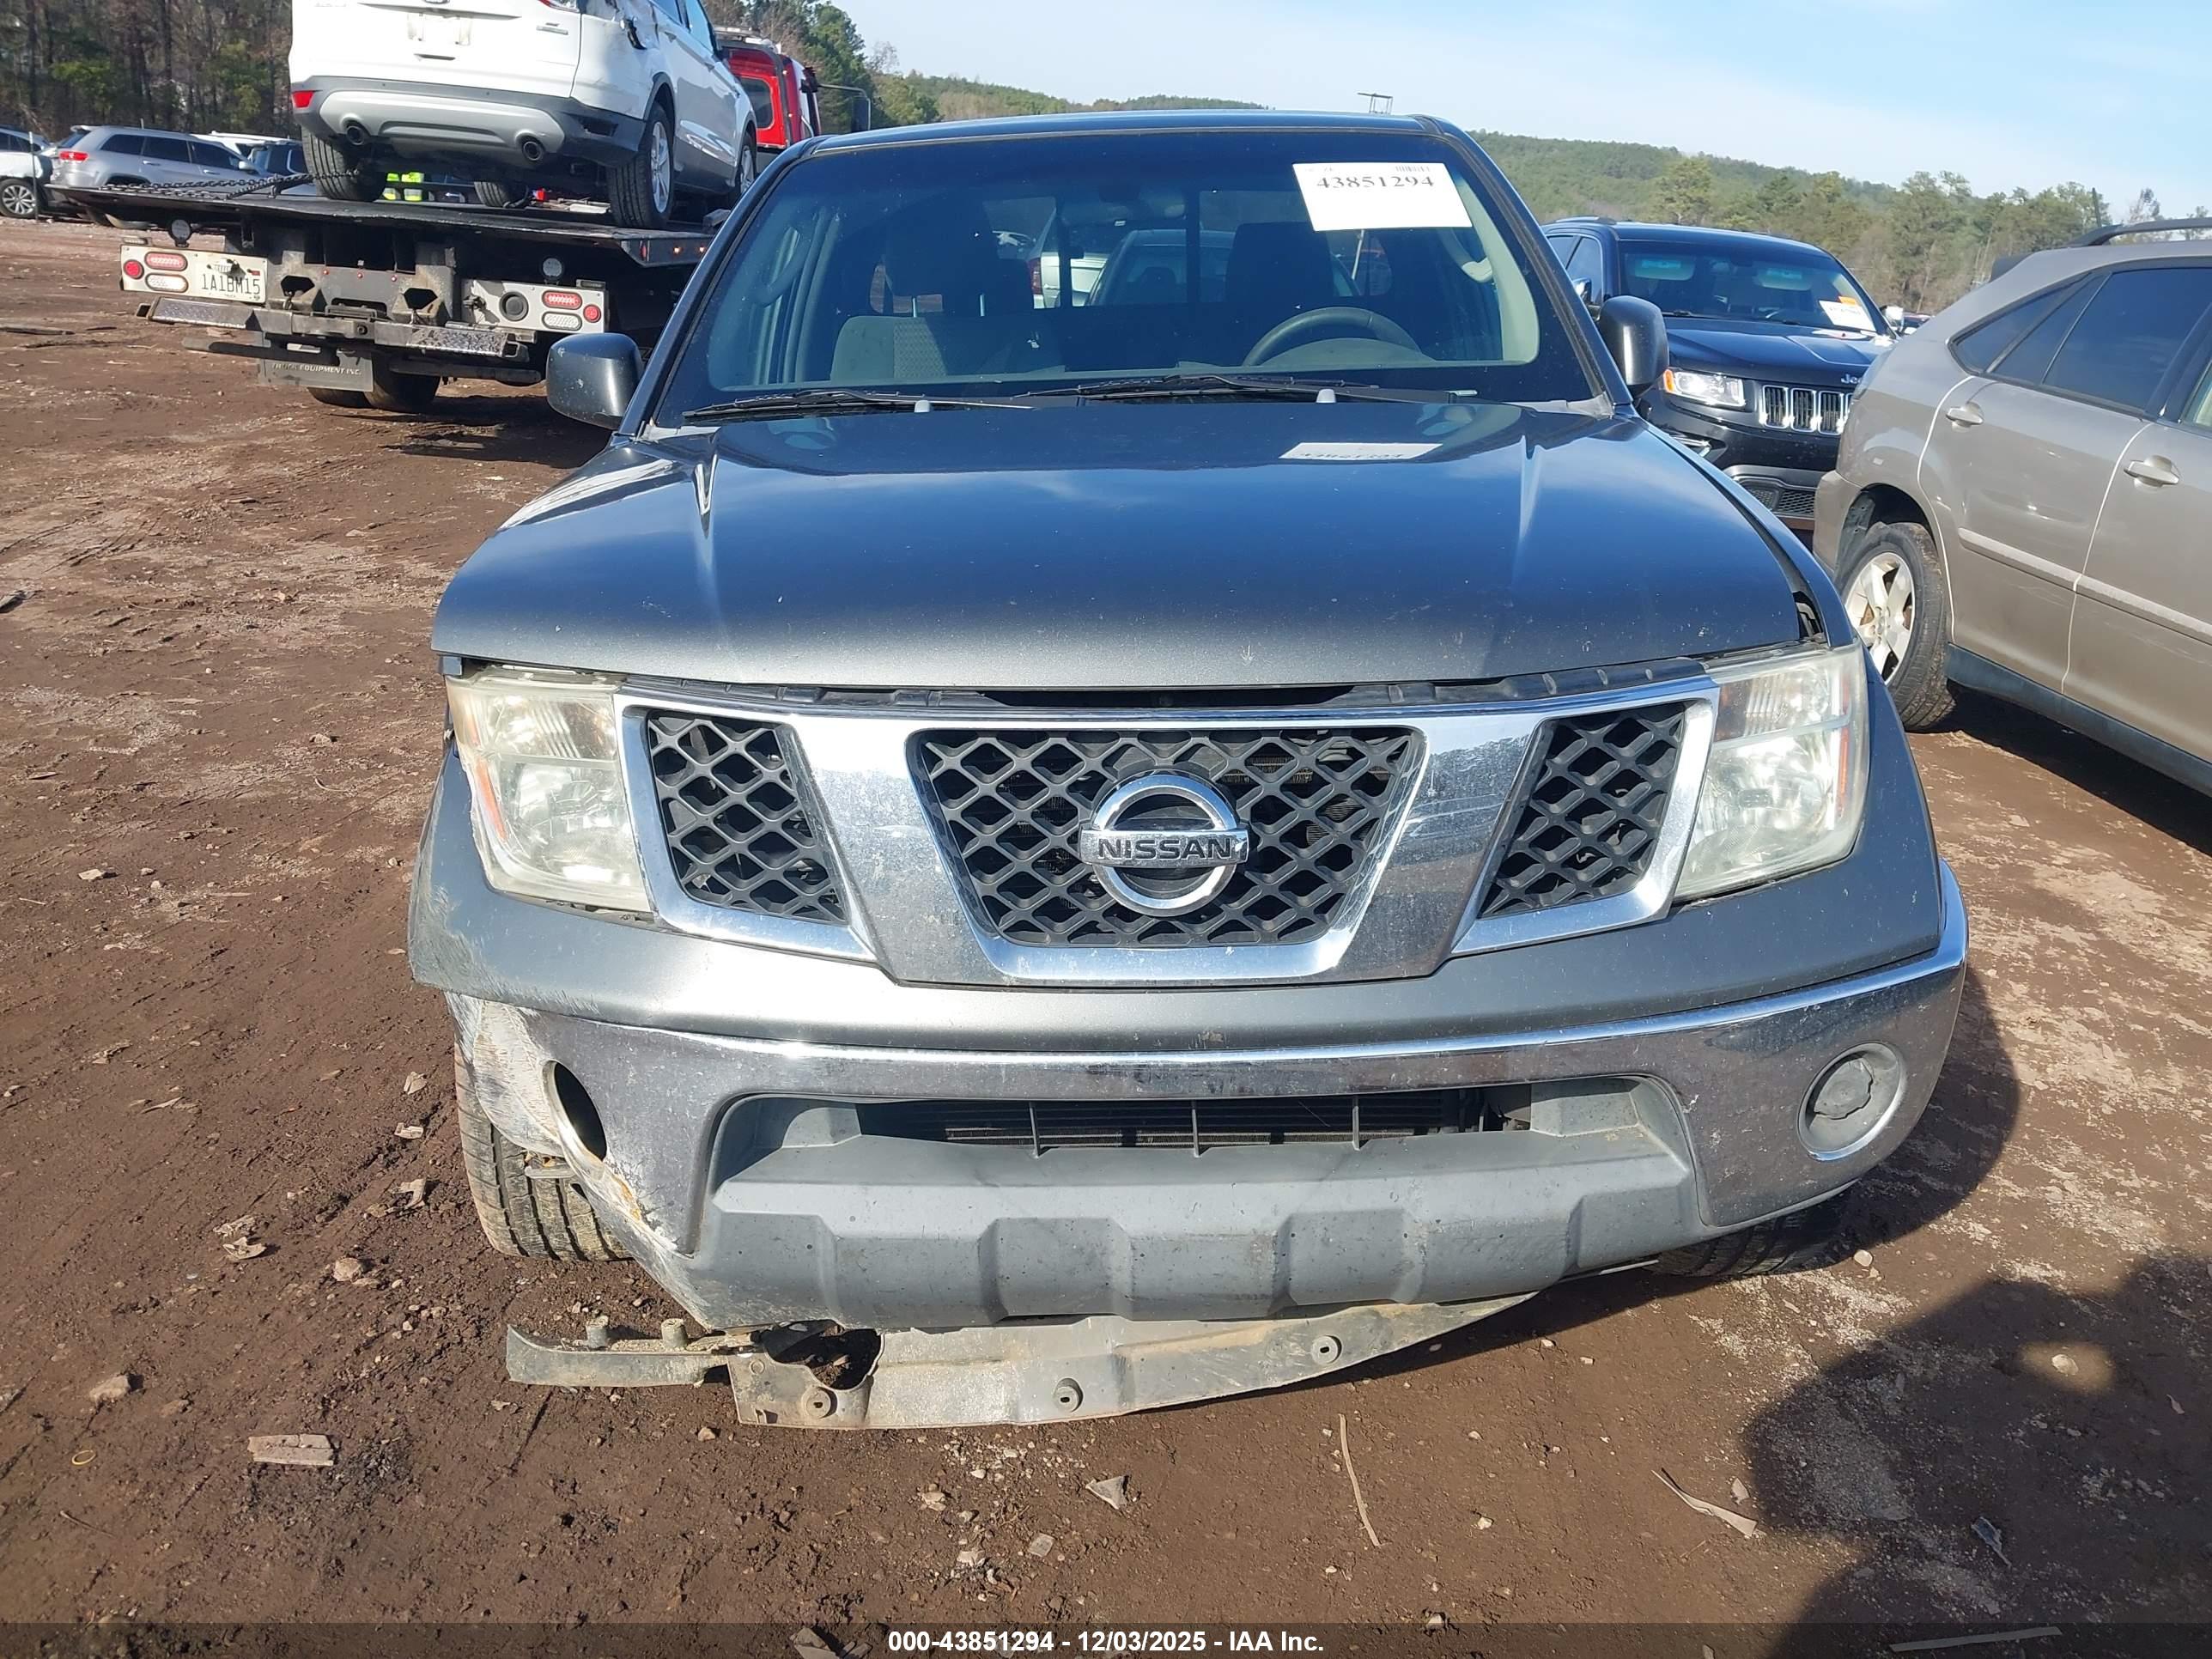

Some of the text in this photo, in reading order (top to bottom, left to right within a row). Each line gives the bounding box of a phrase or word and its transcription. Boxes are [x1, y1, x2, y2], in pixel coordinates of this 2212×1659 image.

[1316, 175, 1434, 189] 43851294
[201, 273, 261, 295] 1A1BM15
[299, 363, 345, 374] EQUIPMENT
[346, 367, 362, 375] INC.
[1097, 838, 1232, 860] NISSAN
